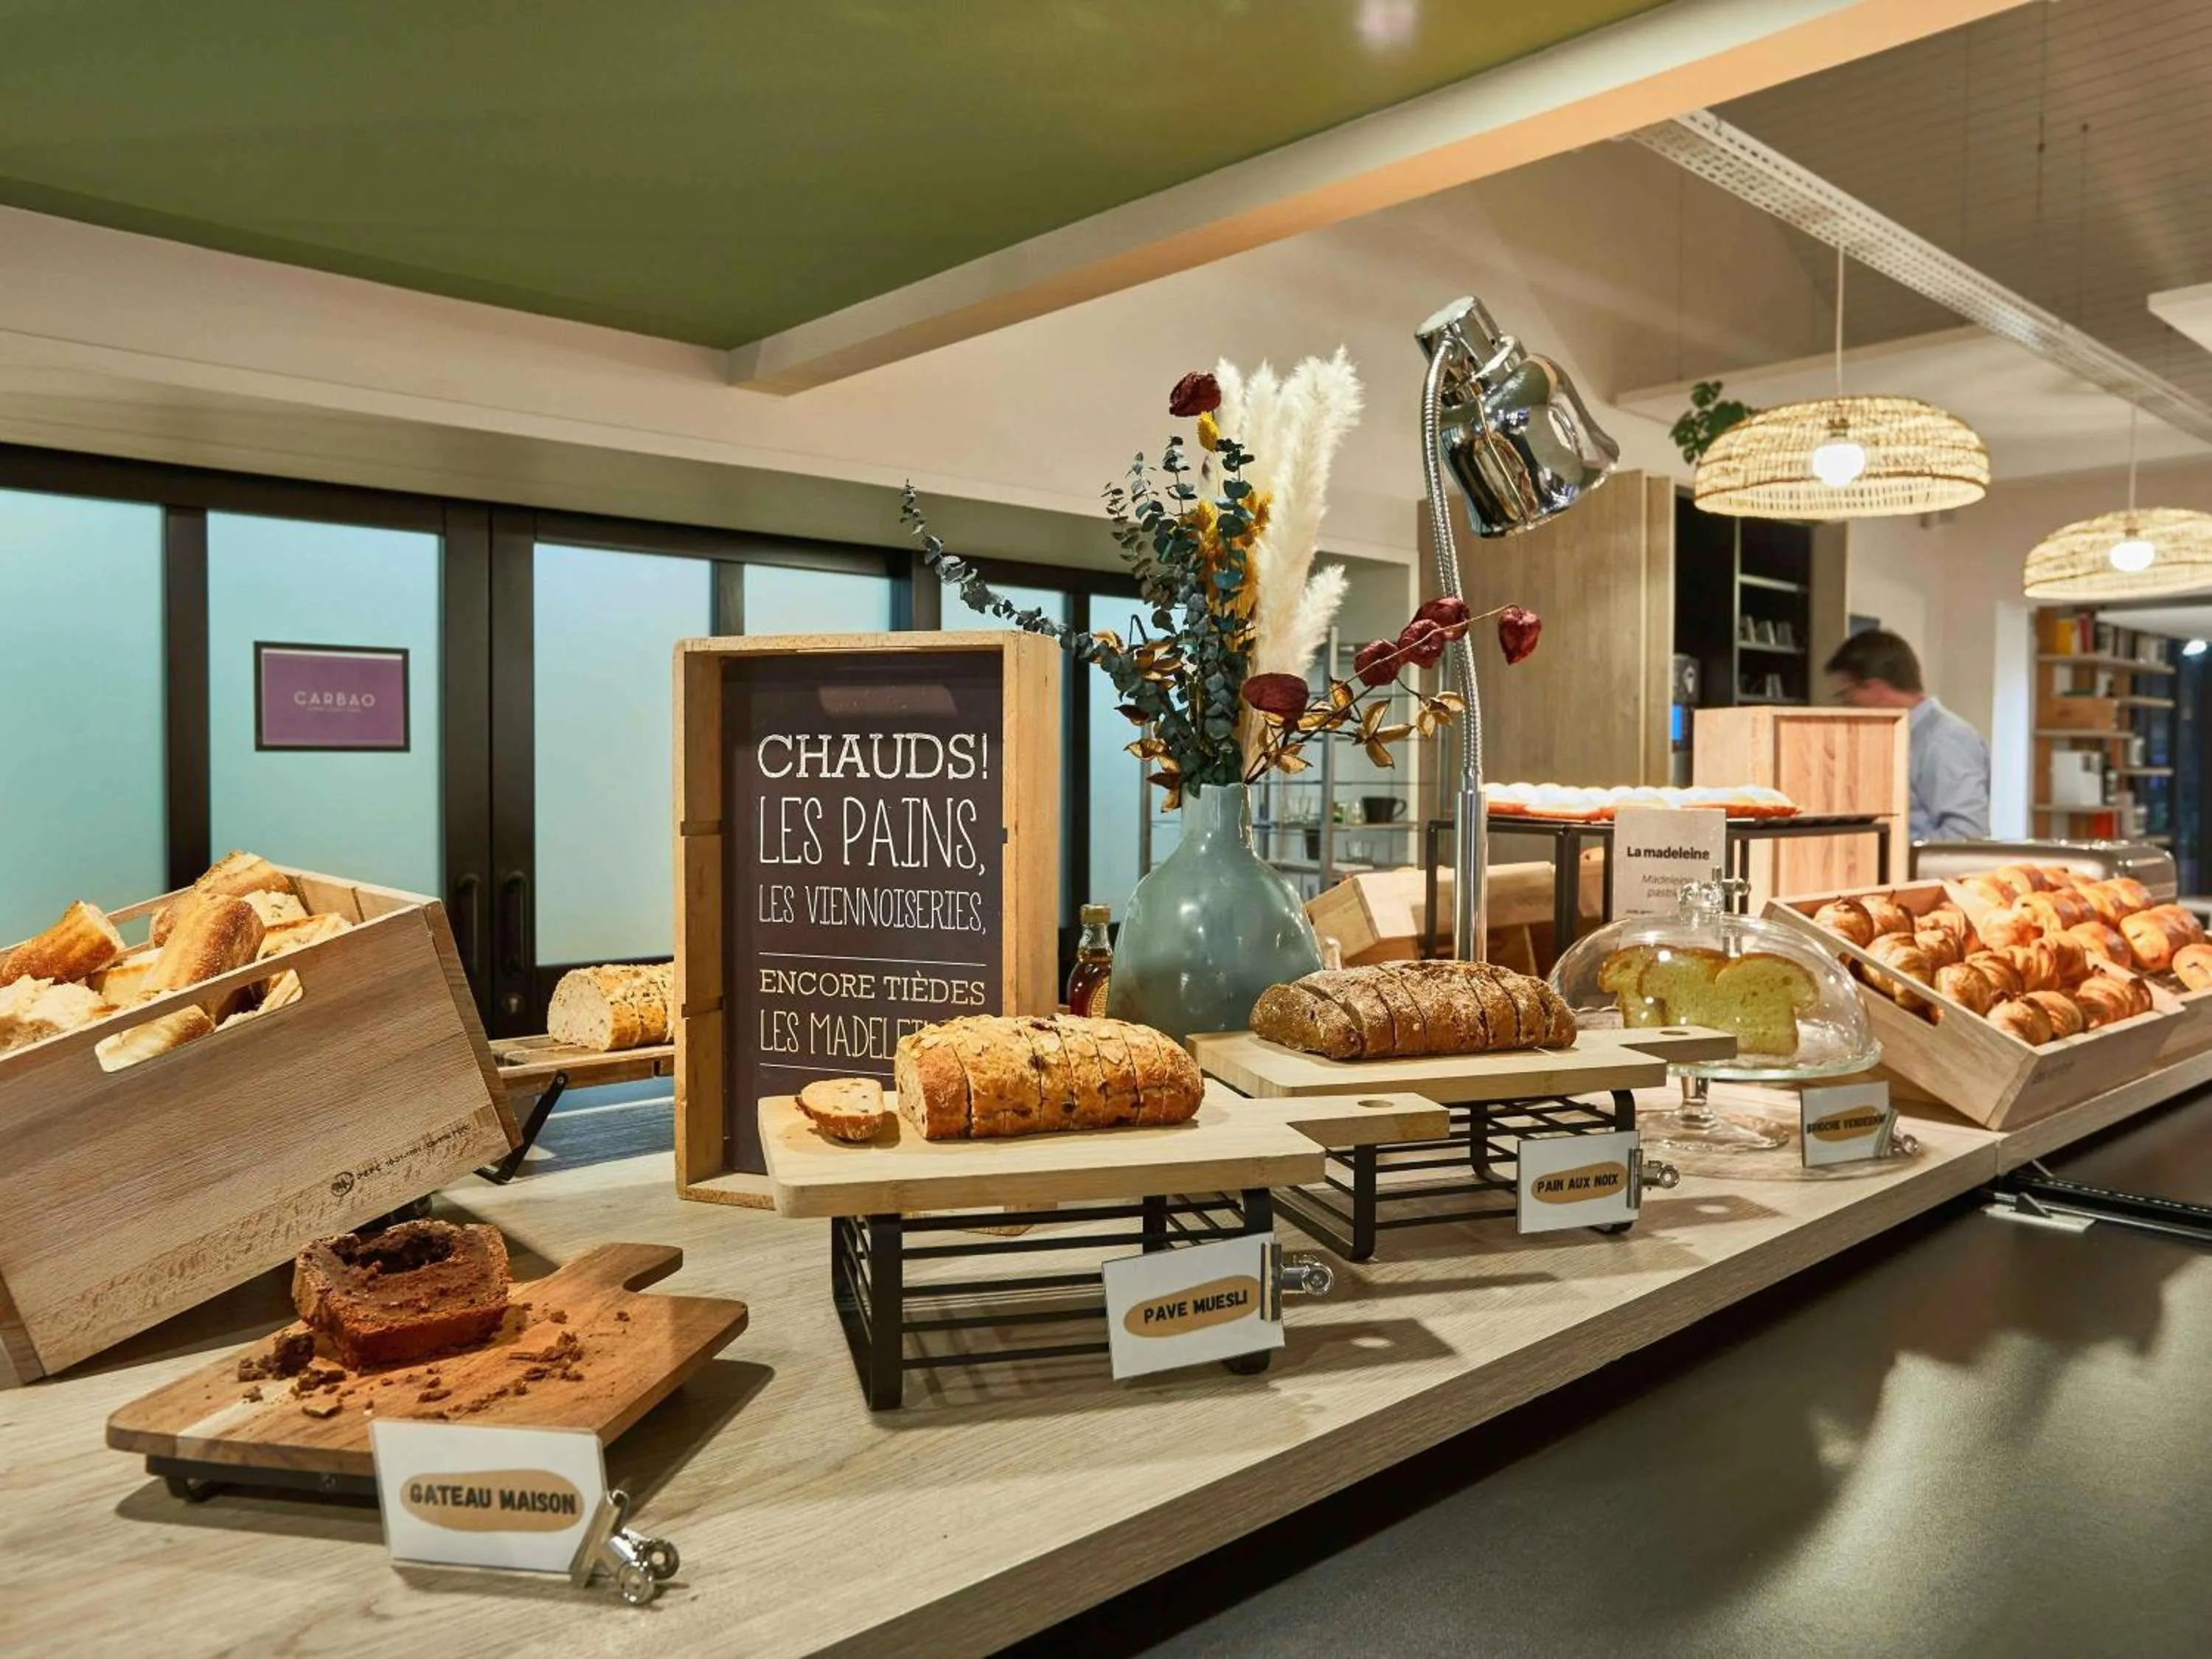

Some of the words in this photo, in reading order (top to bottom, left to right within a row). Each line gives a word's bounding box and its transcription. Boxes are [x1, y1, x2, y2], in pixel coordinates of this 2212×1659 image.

[757, 733, 988, 779] CHAUDS!
[759, 796, 824, 866] LES
[843, 796, 986, 876] PAINS,
[1627, 846, 1642, 858] La
[1644, 846, 1710, 860] madeleine
[759, 884, 795, 923] LES
[804, 885, 987, 936] VIENNOISERIES,
[759, 969, 876, 999] ENCORE
[883, 970, 986, 1006] TIÈDES
[759, 1009, 799, 1052] LES
[1537, 1180, 1564, 1194] PAIN
[1568, 1178, 1590, 1191] AUX
[1593, 1173, 1618, 1187] NOIX
[1144, 1301, 1187, 1324] PAVE
[1192, 1289, 1248, 1315] MUESLI
[409, 1483, 492, 1507] GATEAU
[498, 1489, 577, 1514] MAISON
